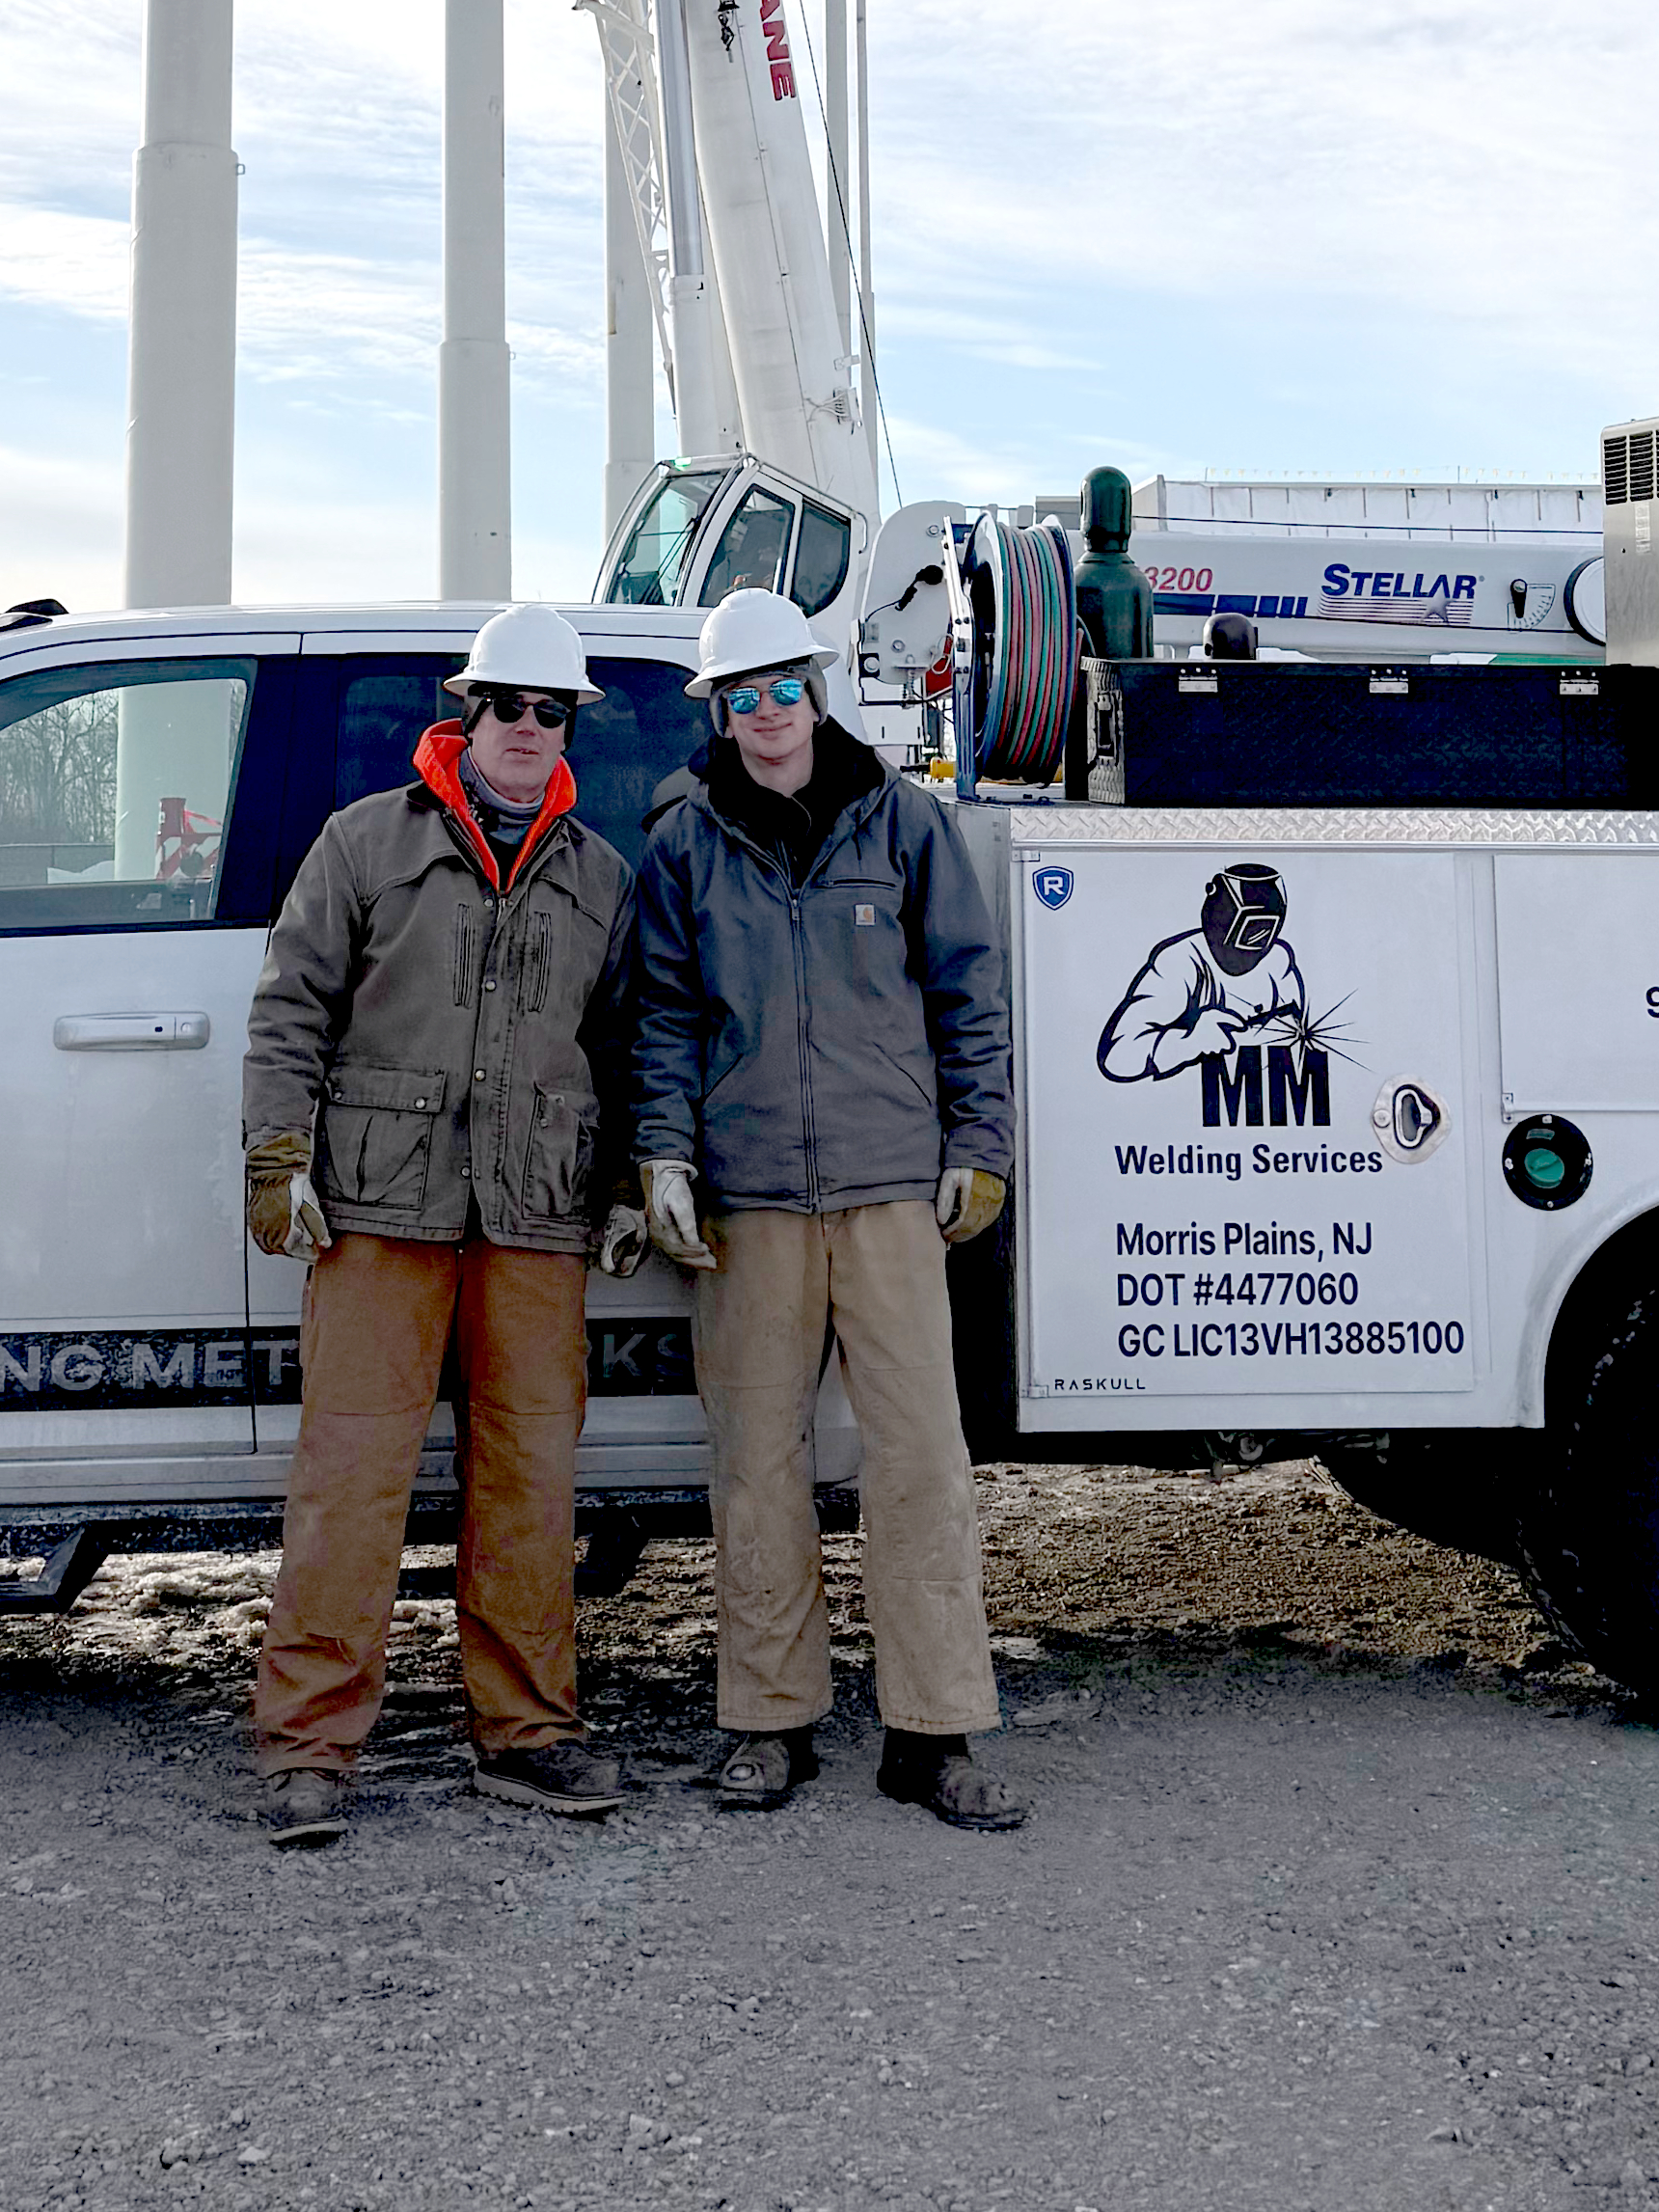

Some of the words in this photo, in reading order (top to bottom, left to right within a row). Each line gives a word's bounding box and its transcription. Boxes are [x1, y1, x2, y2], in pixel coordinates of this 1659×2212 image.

[1144, 566, 1212, 592] 3200
[1320, 563, 1478, 599] STELLAR
[1044, 876, 1066, 895] R
[1201, 1045, 1331, 1127] MM
[1114, 1145, 1241, 1181] Welding
[1252, 1144, 1383, 1174] Services
[1117, 1221, 1215, 1255] Morris
[1224, 1221, 1324, 1263] Plains,
[1333, 1222, 1373, 1255] NJ
[1117, 1273, 1185, 1306] DOT
[1193, 1272, 1359, 1306] #4477060
[1118, 1324, 1165, 1357] GC
[1174, 1321, 1465, 1356] LIC13VH13885100
[1054, 1379, 1146, 1390] RASKULL
